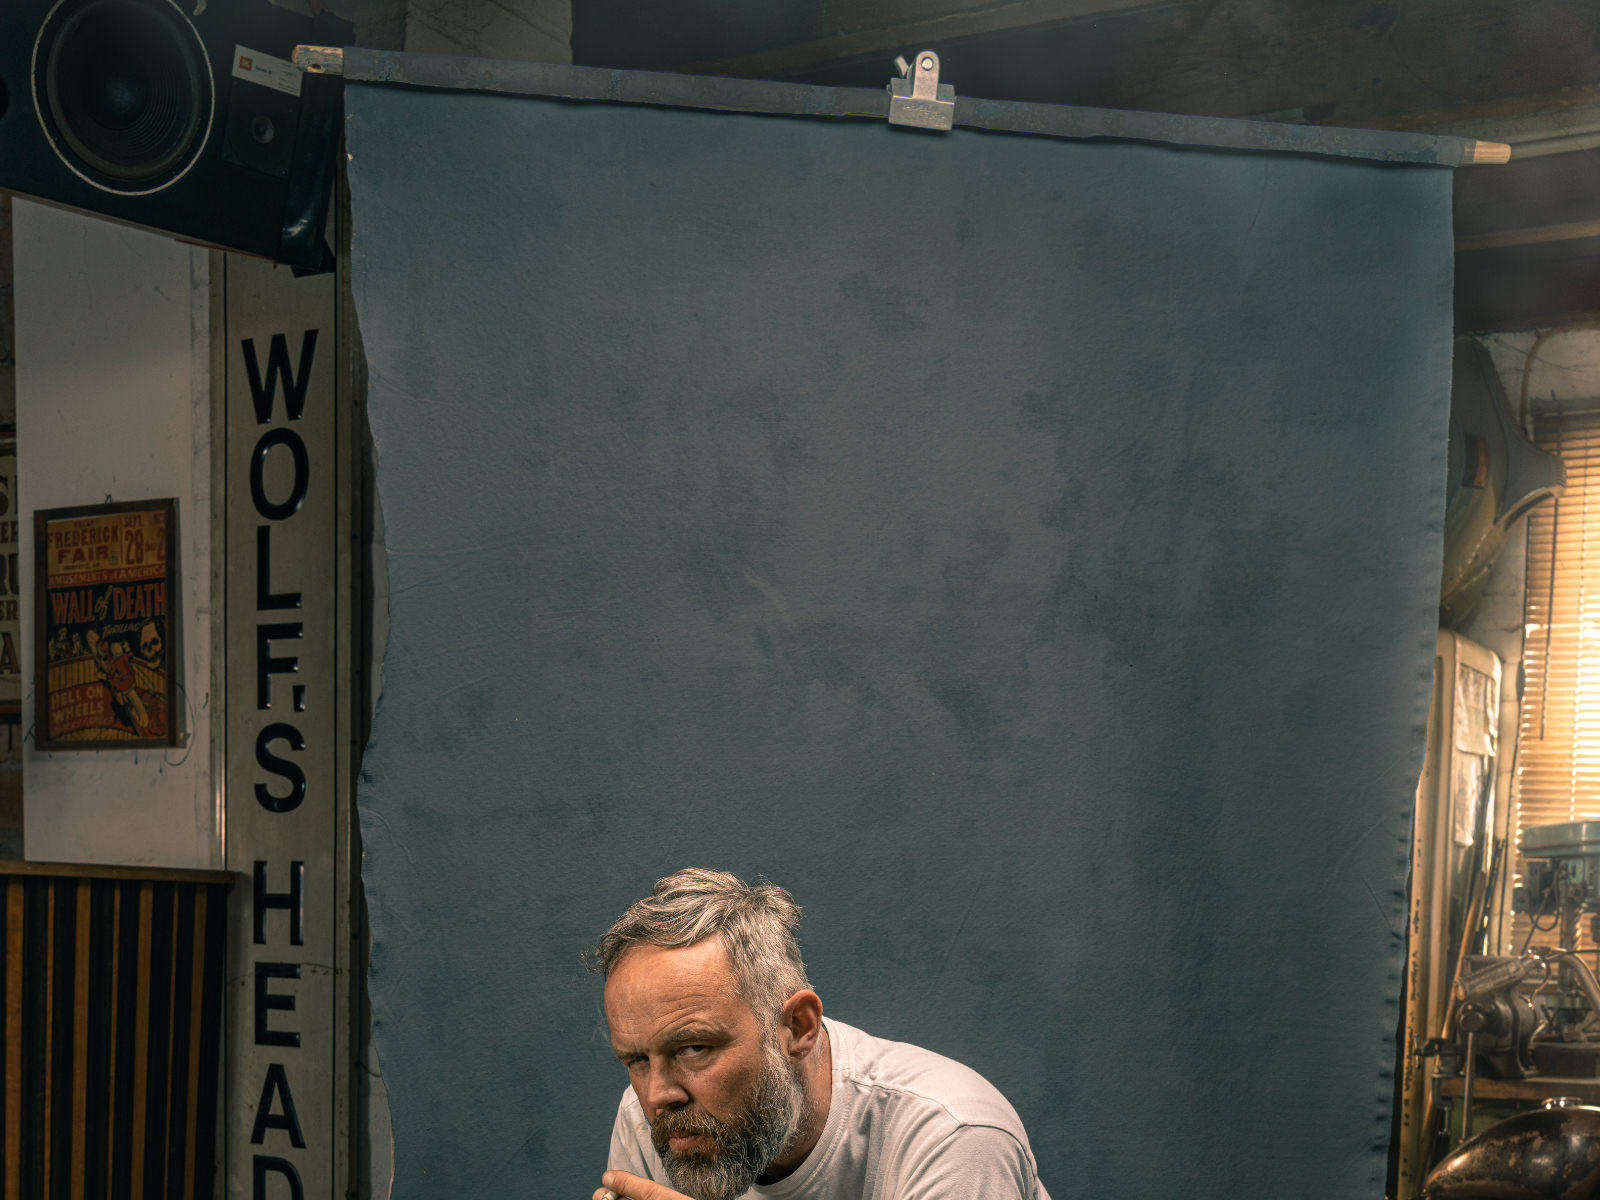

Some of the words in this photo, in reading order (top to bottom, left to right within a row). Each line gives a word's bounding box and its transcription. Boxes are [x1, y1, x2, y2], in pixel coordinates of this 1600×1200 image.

[47, 525, 119, 549] FREDERICK
[125, 529, 143, 565] 28
[57, 545, 108, 565] FAIR
[241, 328, 319, 813] WOLF'S
[50, 588, 95, 625] WALL
[94, 584, 113, 621] of
[113, 582, 165, 621] DEATH
[50, 687, 83, 710] HELL
[86, 684, 103, 699] ON
[52, 700, 104, 724] WHEELS
